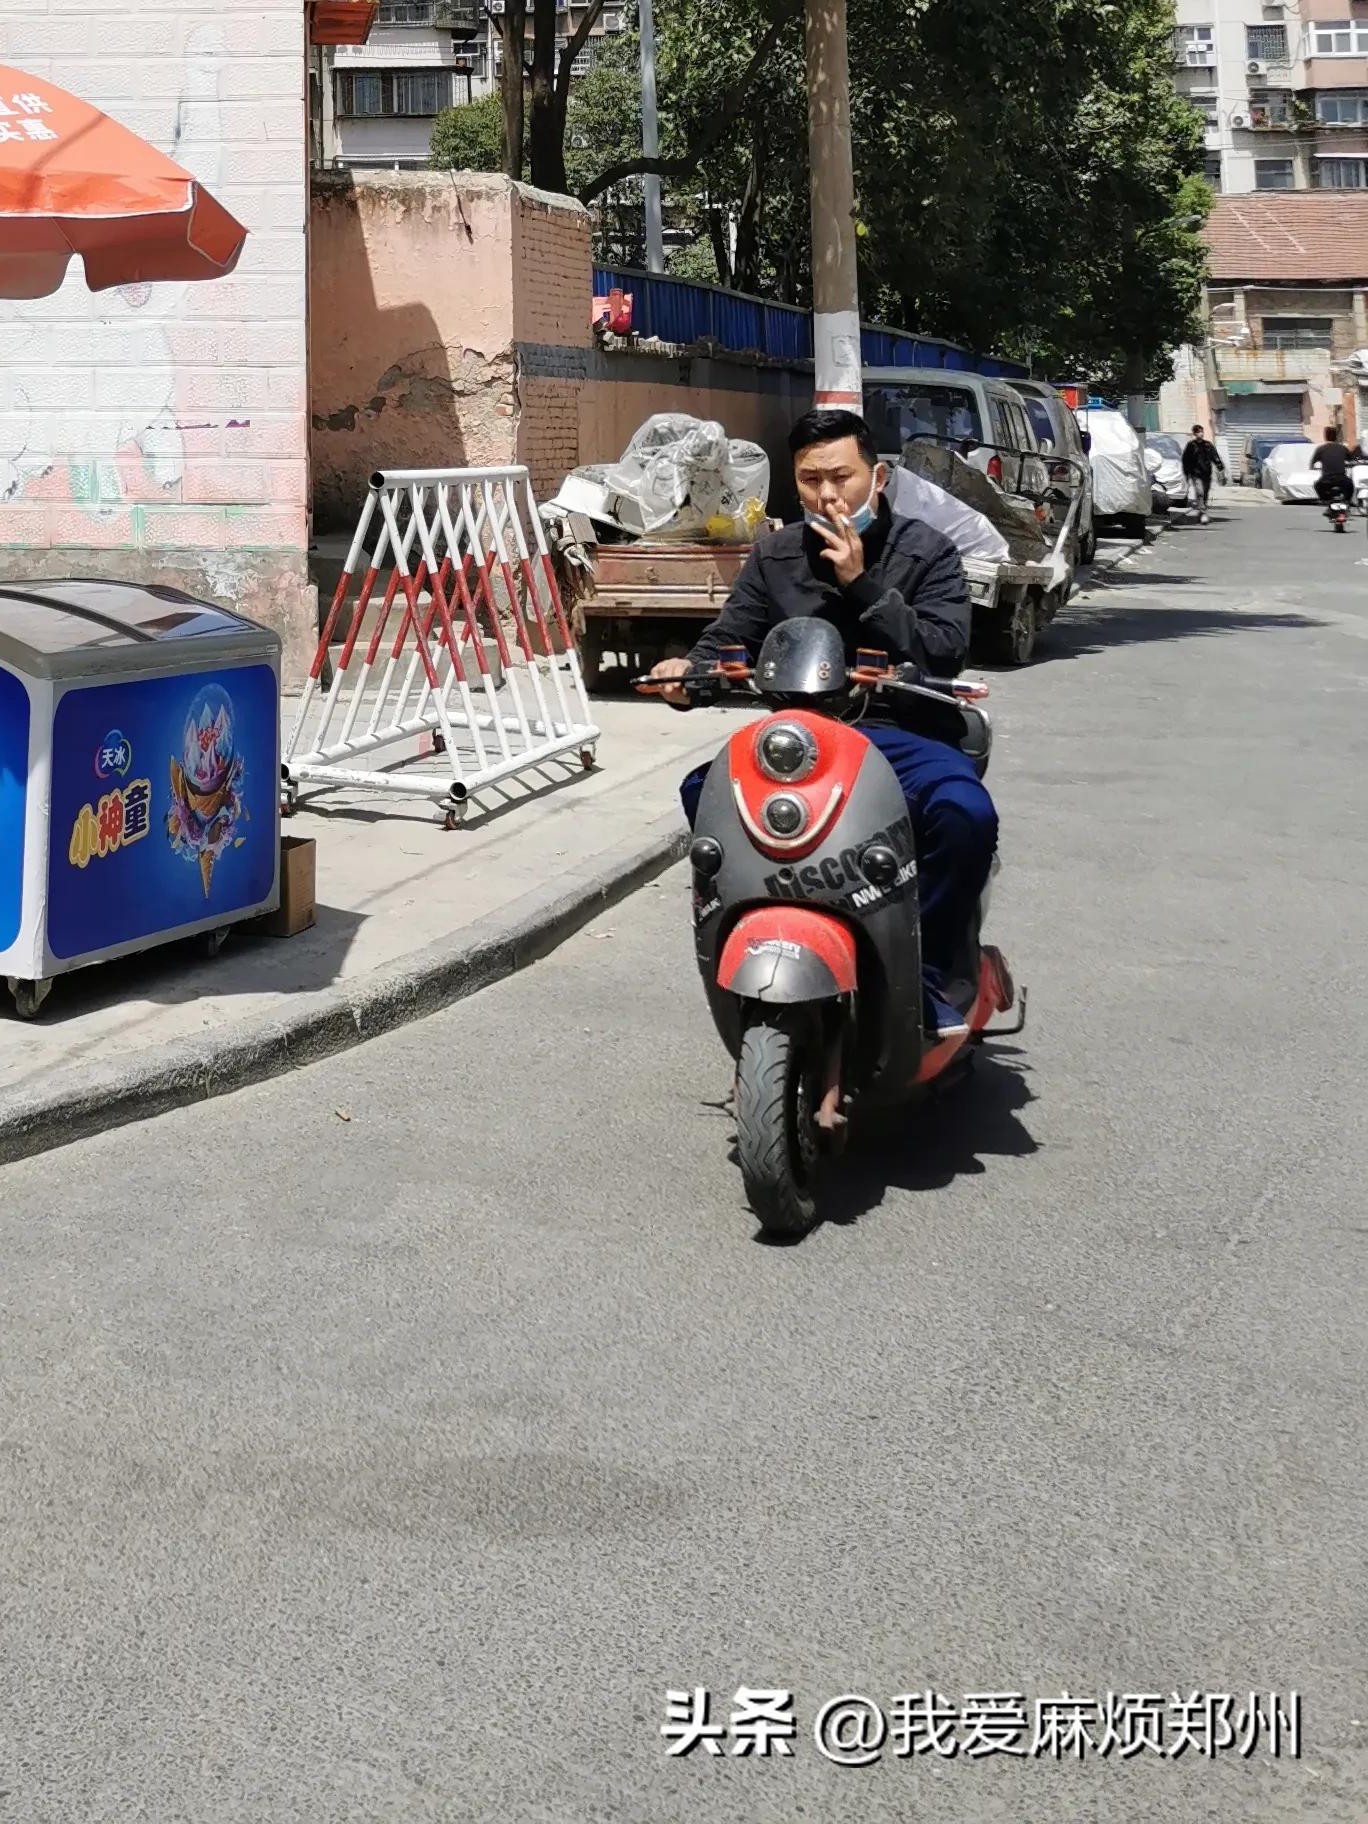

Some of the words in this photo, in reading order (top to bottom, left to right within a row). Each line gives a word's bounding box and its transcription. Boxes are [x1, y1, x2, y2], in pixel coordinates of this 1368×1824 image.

[101, 747, 126, 768] 天冰
[69, 778, 151, 868] 小神童
